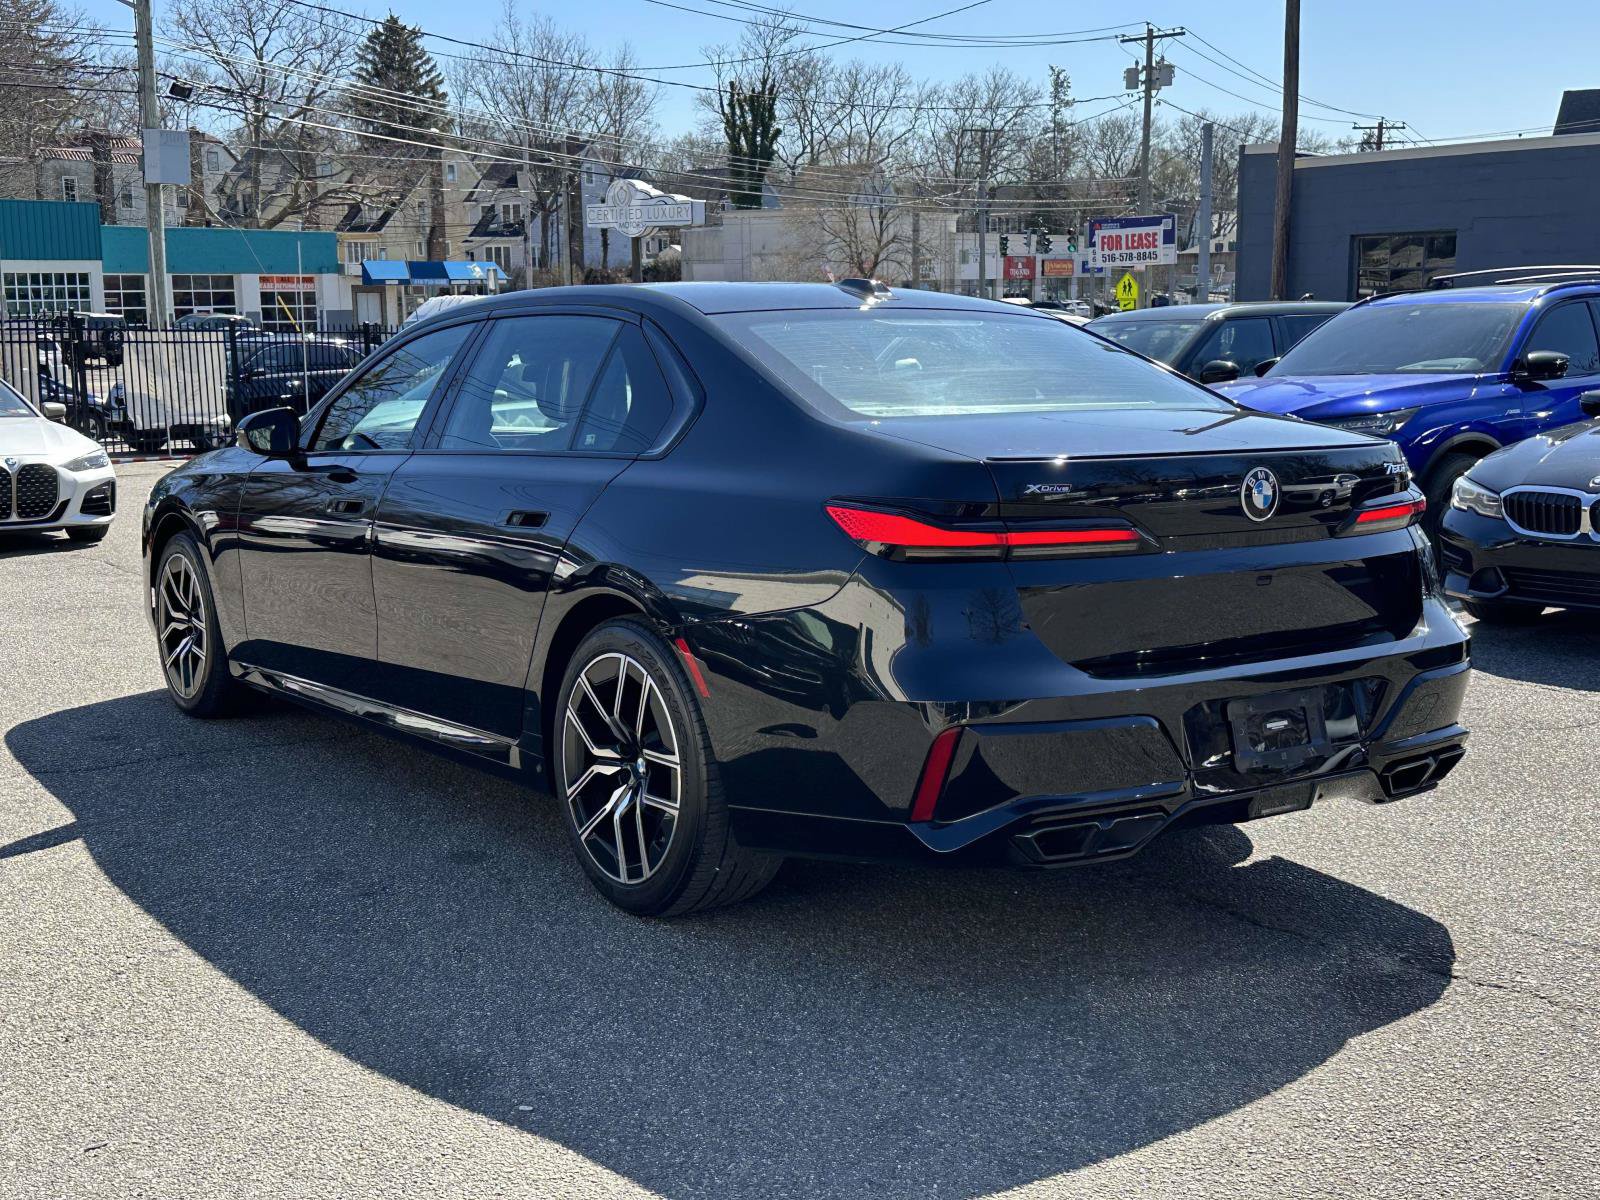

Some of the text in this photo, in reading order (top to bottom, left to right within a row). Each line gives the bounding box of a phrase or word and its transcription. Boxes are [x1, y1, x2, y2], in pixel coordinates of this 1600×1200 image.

[588, 207, 690, 221] CERTIFIED LUXURY
[618, 221, 646, 229] MOTORS
[1101, 232, 1158, 251] FOR LEASE
[1102, 250, 1158, 263] 516-578-8845
[1247, 471, 1274, 488] BMW
